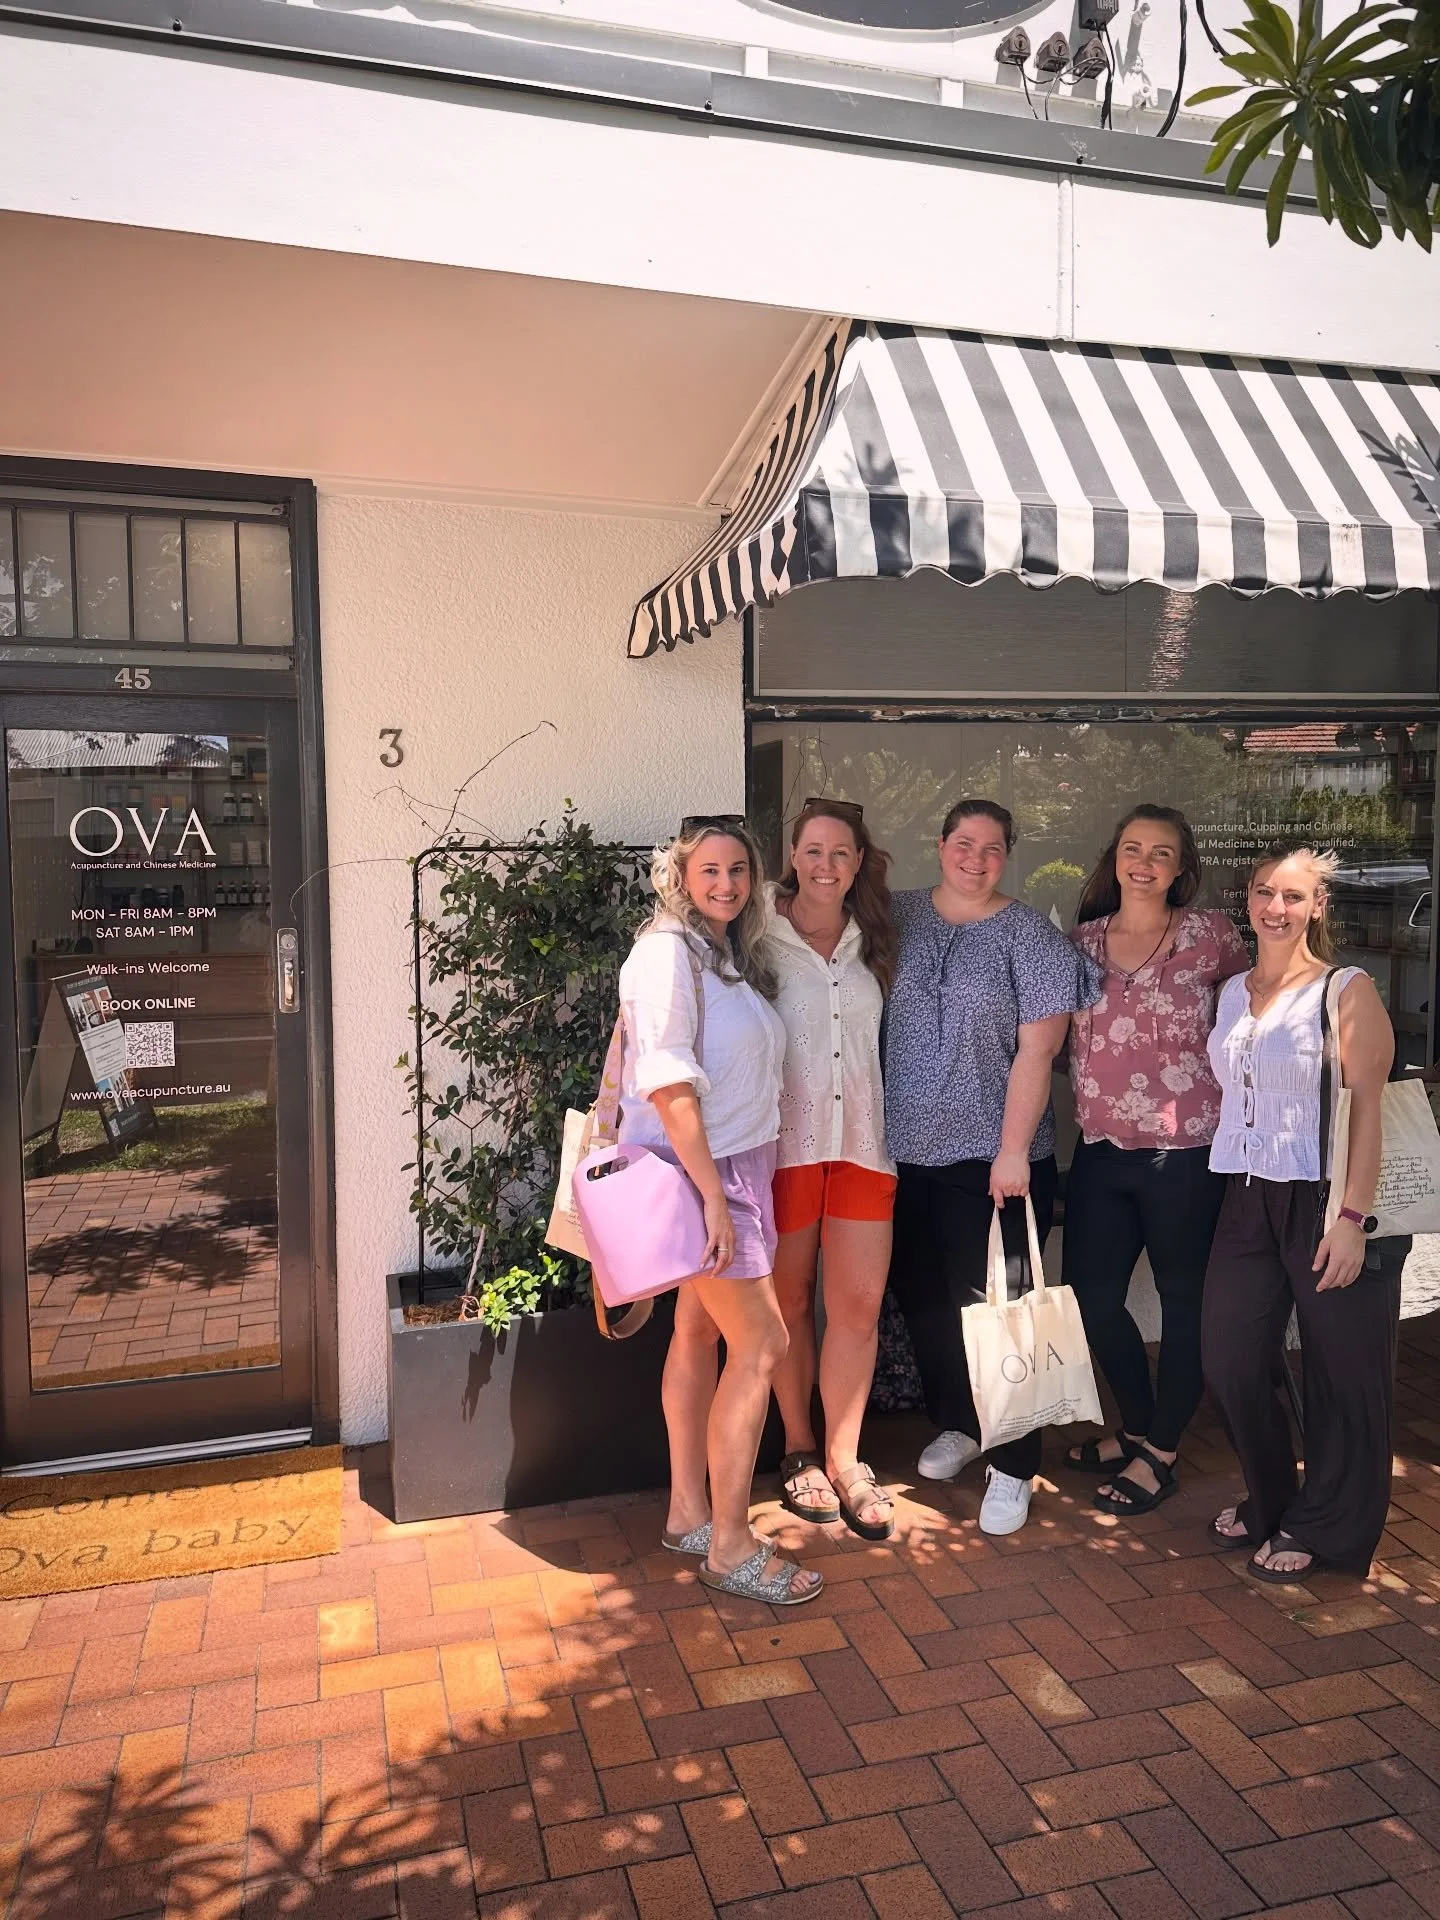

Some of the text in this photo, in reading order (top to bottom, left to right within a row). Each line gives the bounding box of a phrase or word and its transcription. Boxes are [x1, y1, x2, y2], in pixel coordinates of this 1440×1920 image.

[114, 668, 151, 690] 45
[379, 728, 404, 768] 3
[69, 806, 217, 857] OVA
[1191, 821, 1353, 834] upuncture, Cupping and Chinese
[1208, 839, 1255, 849] Medicine
[1257, 839, 1270, 851] by
[70, 860, 217, 871] Acupuncture and Chinese Medicine
[71, 909, 105, 921] MON
[120, 909, 140, 919] FRI
[143, 908, 173, 919] 8AM
[188, 907, 217, 918] 8PM
[96, 927, 121, 938] SAT
[124, 927, 155, 937] 8AM
[169, 926, 194, 936] 1PM
[148, 962, 210, 973] Welcome
[101, 998, 196, 1011] BOOK ONLINE
[70, 1083, 231, 1101] www.ovaacupuncture.au
[1001, 1341, 1064, 1384] OVA
[142, 1515, 310, 1556] baby
